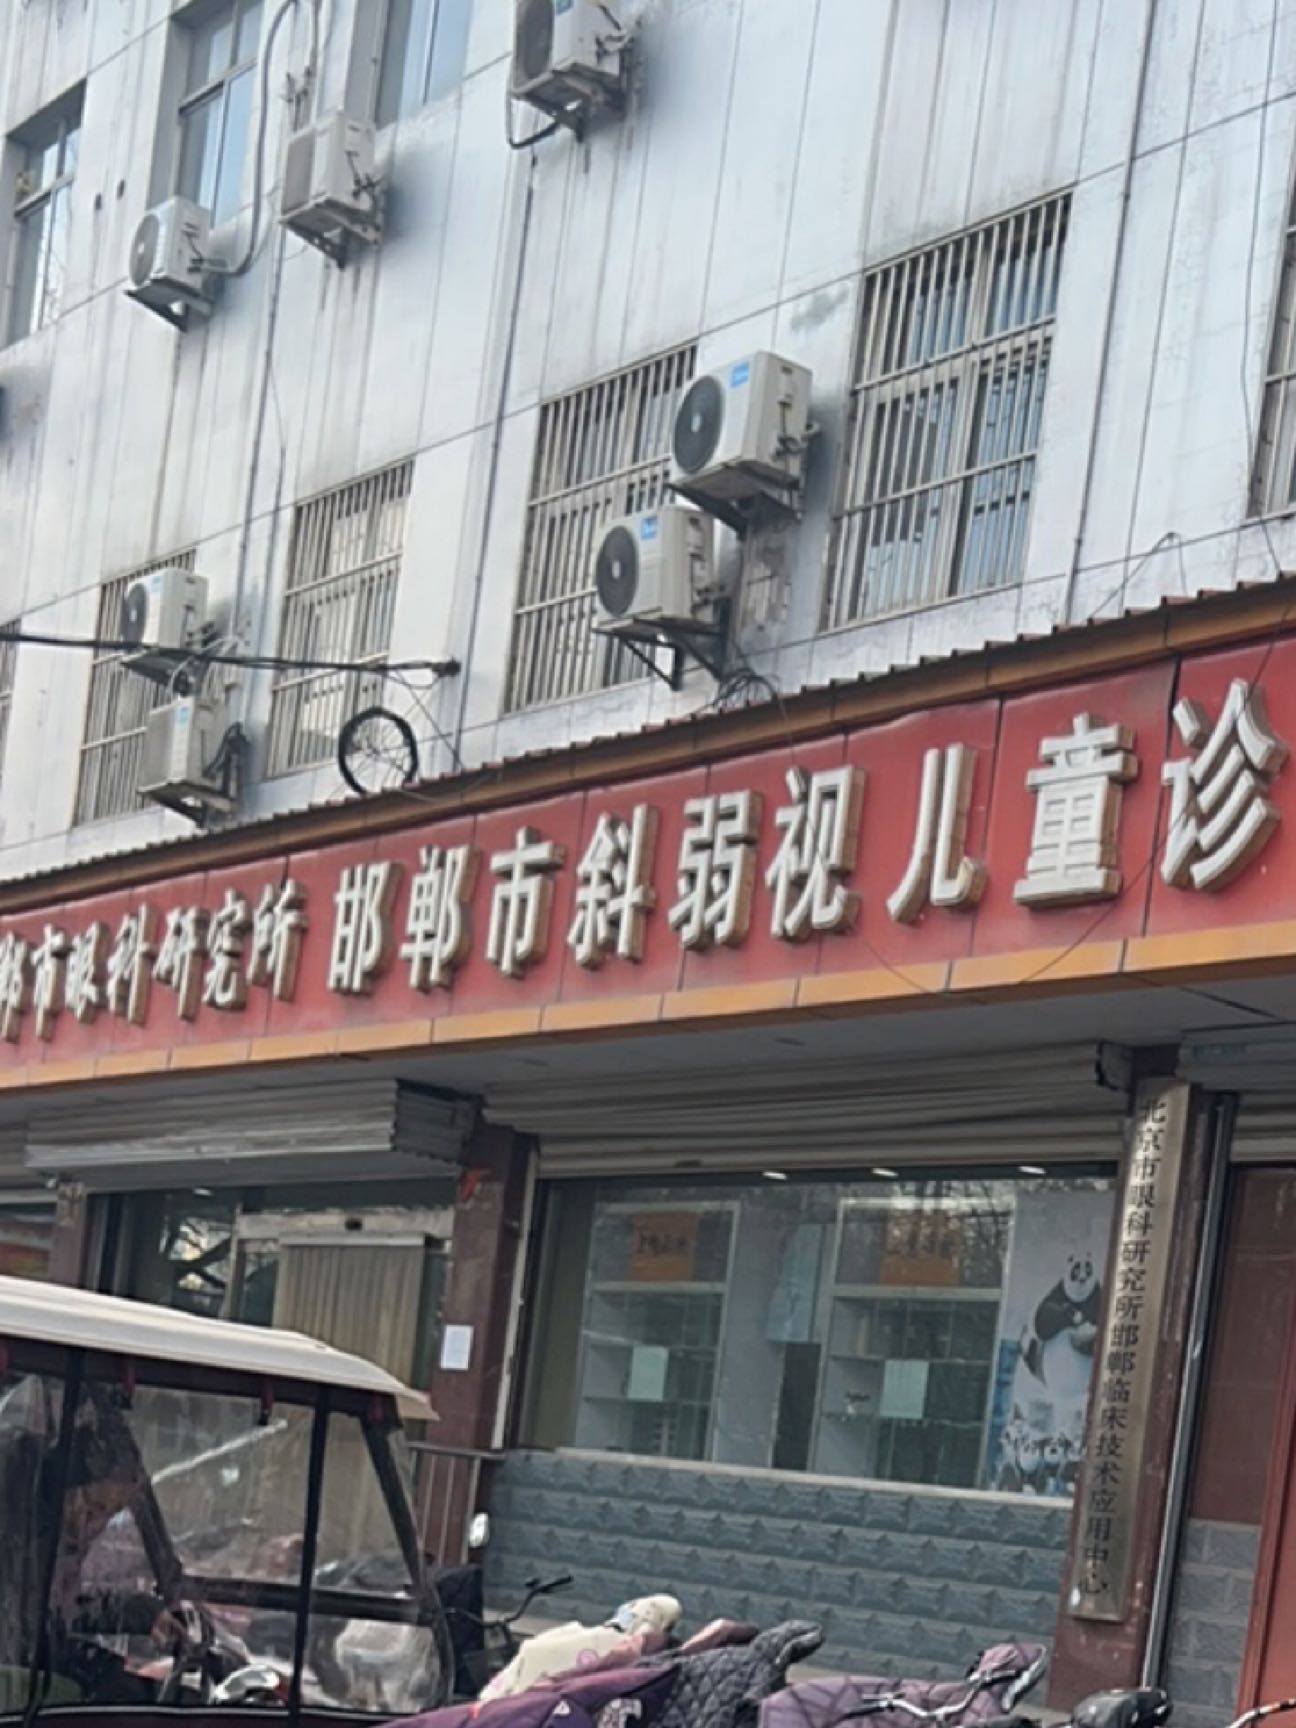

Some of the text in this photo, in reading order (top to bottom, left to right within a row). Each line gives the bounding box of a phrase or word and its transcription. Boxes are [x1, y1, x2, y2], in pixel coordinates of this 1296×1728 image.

[1078, 1098, 1167, 1596] 北京市眼科研究所邯郸临床技术应用中心
